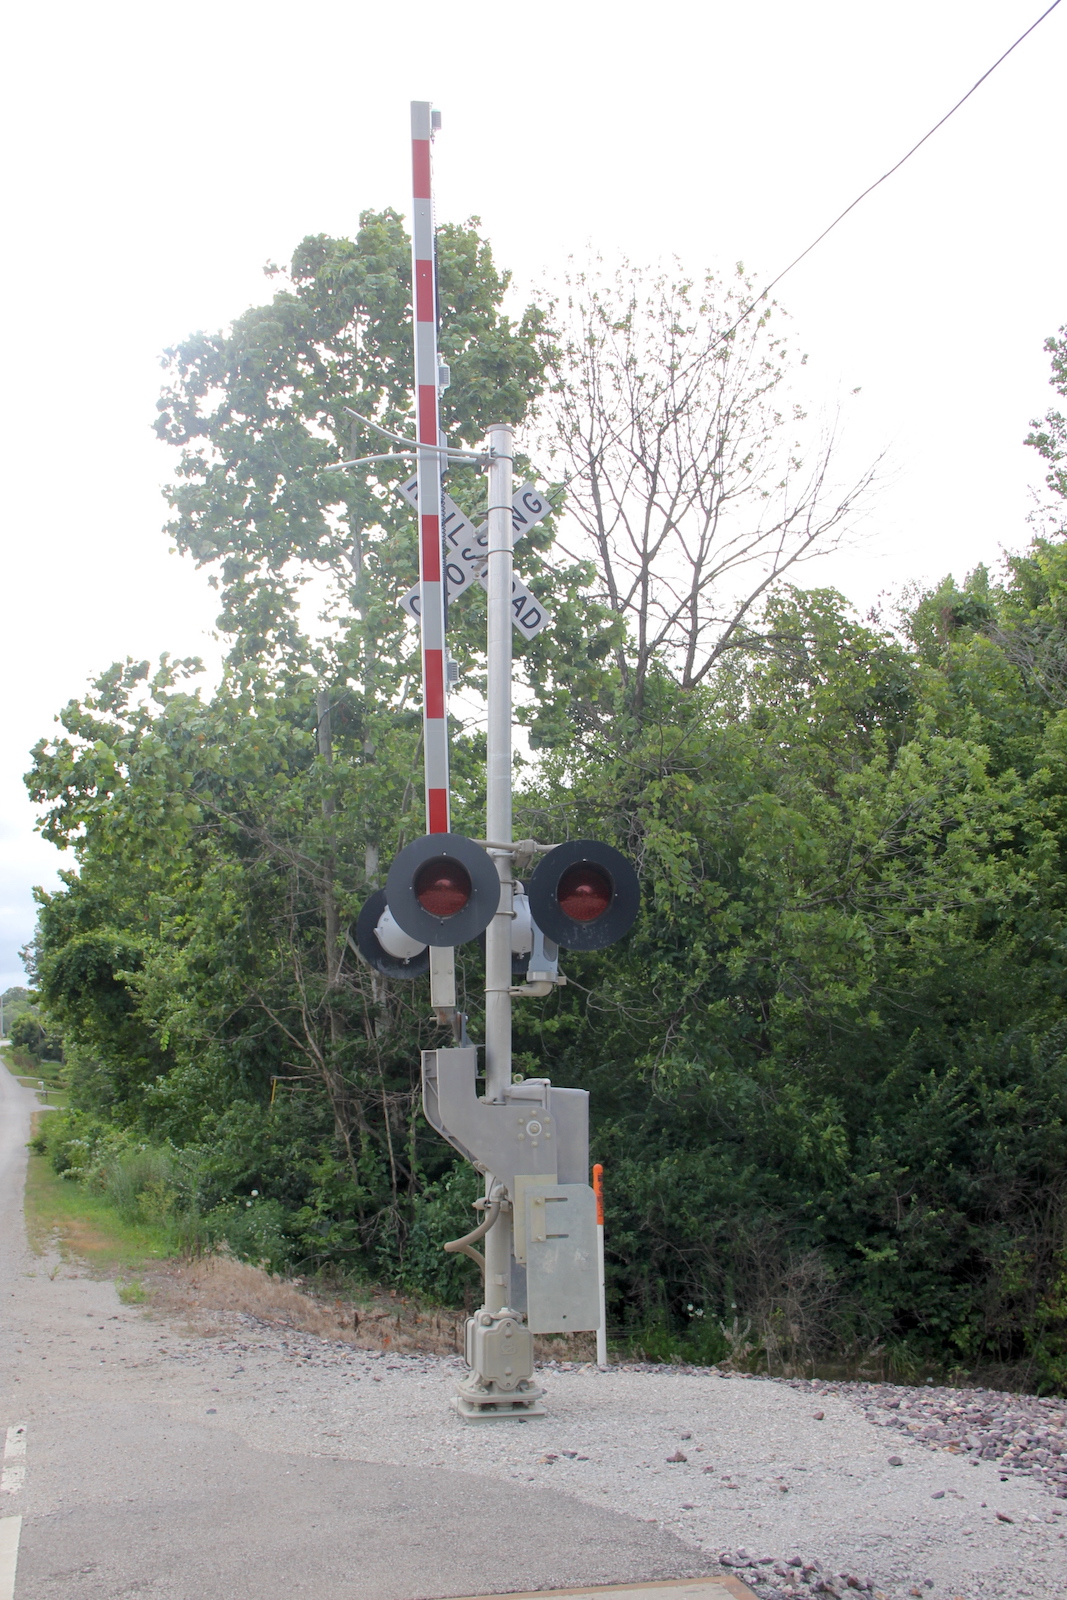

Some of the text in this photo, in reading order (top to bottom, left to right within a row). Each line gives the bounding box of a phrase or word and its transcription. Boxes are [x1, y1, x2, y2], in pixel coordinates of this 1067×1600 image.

[407, 480, 542, 630] IL AD
[409, 492, 543, 617] COSNG
